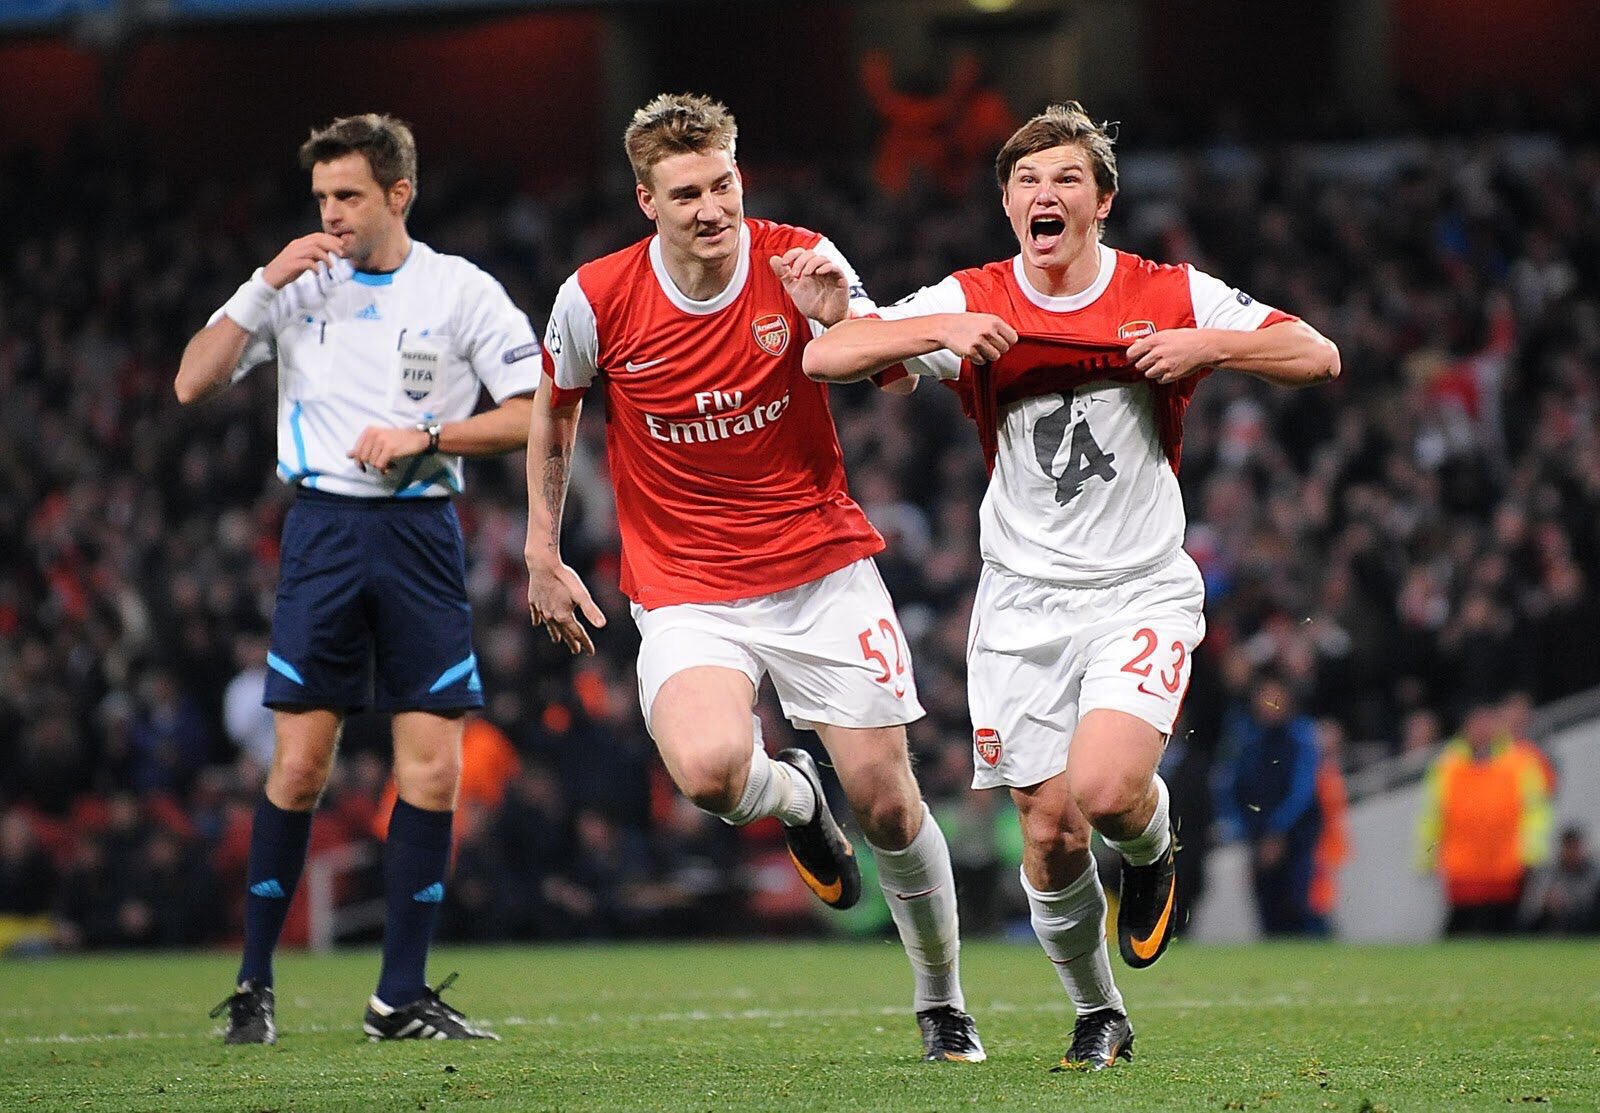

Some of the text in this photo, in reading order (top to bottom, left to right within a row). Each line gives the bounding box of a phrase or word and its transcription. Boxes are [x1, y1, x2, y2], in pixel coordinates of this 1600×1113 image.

[403, 368, 433, 381] FIFA
[694, 390, 743, 414] Fly
[858, 618, 904, 684] 52
[1120, 628, 1186, 693] 23
